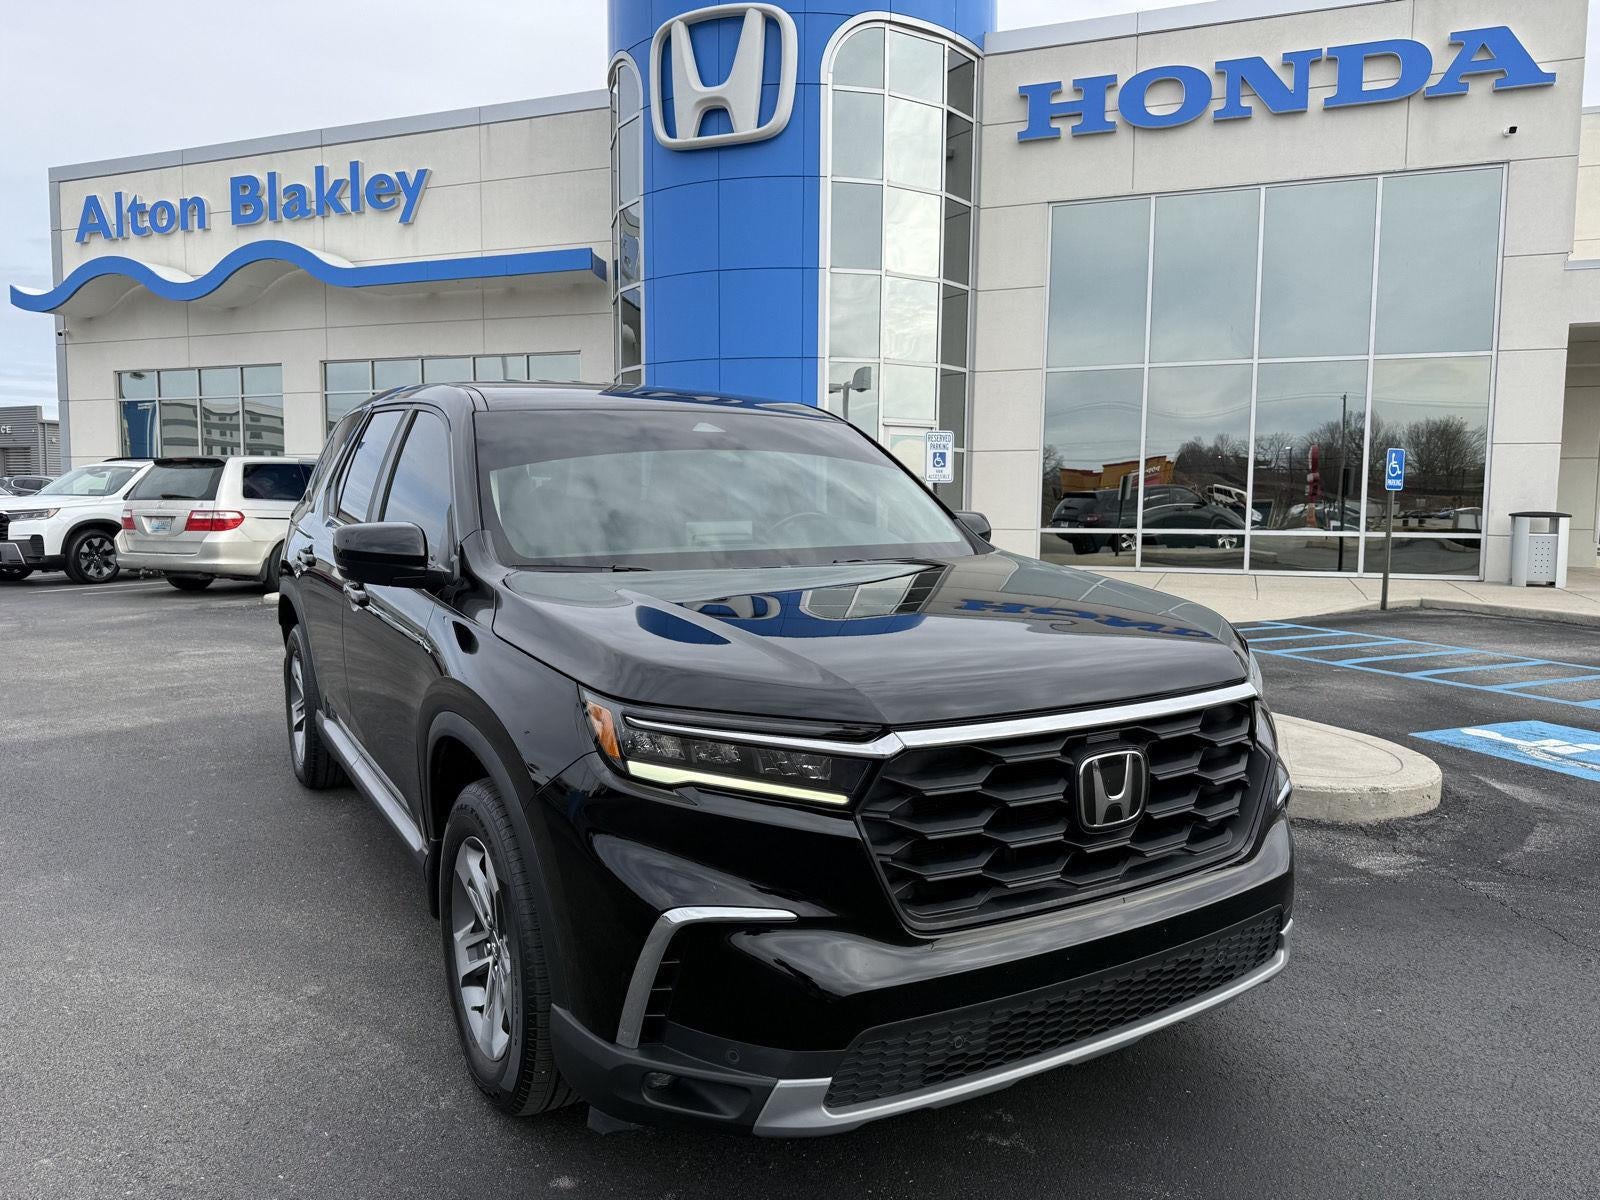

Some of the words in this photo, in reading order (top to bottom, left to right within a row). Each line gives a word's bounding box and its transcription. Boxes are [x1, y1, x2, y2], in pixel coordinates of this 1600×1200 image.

[1017, 25, 1557, 142] HONDA
[75, 191, 209, 244] Alton
[230, 161, 431, 224] Blakley
[928, 434, 951, 442] RESERVED
